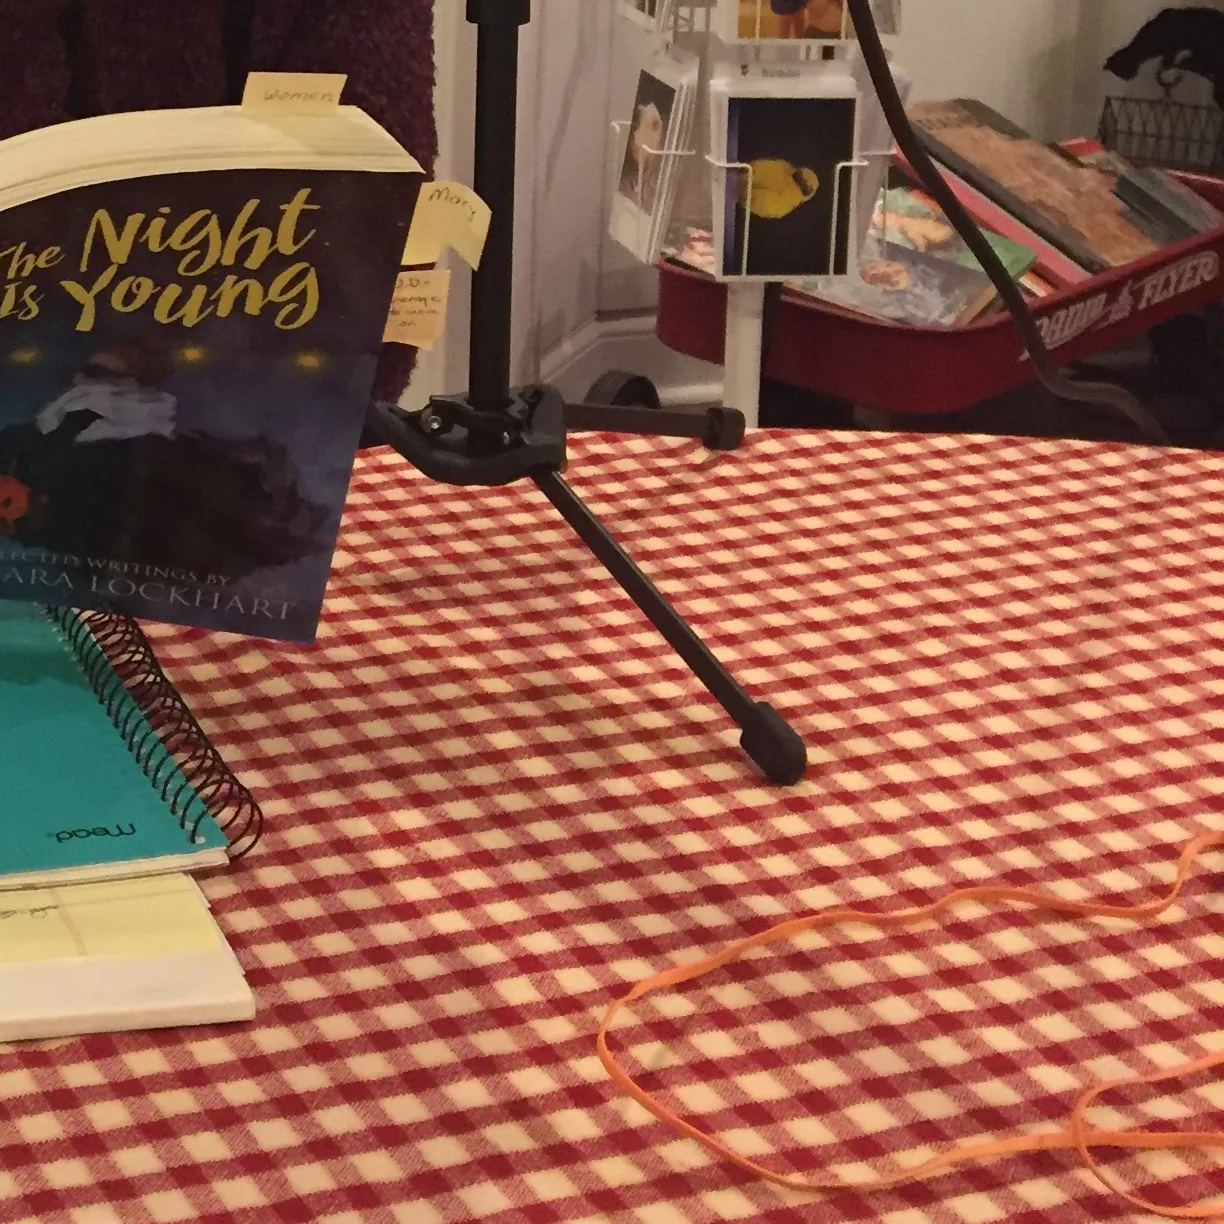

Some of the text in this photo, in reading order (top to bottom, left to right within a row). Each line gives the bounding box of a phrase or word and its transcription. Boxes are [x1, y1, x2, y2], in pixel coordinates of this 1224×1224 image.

[264, 88, 333, 103] Women
[79, 186, 322, 277] Night
[58, 261, 320, 332] Young
[1133, 250, 1221, 311] FLYER
[86, 556, 198, 583] WRITINGS
[207, 572, 231, 587] BY
[90, 575, 298, 621] LOCKHART
